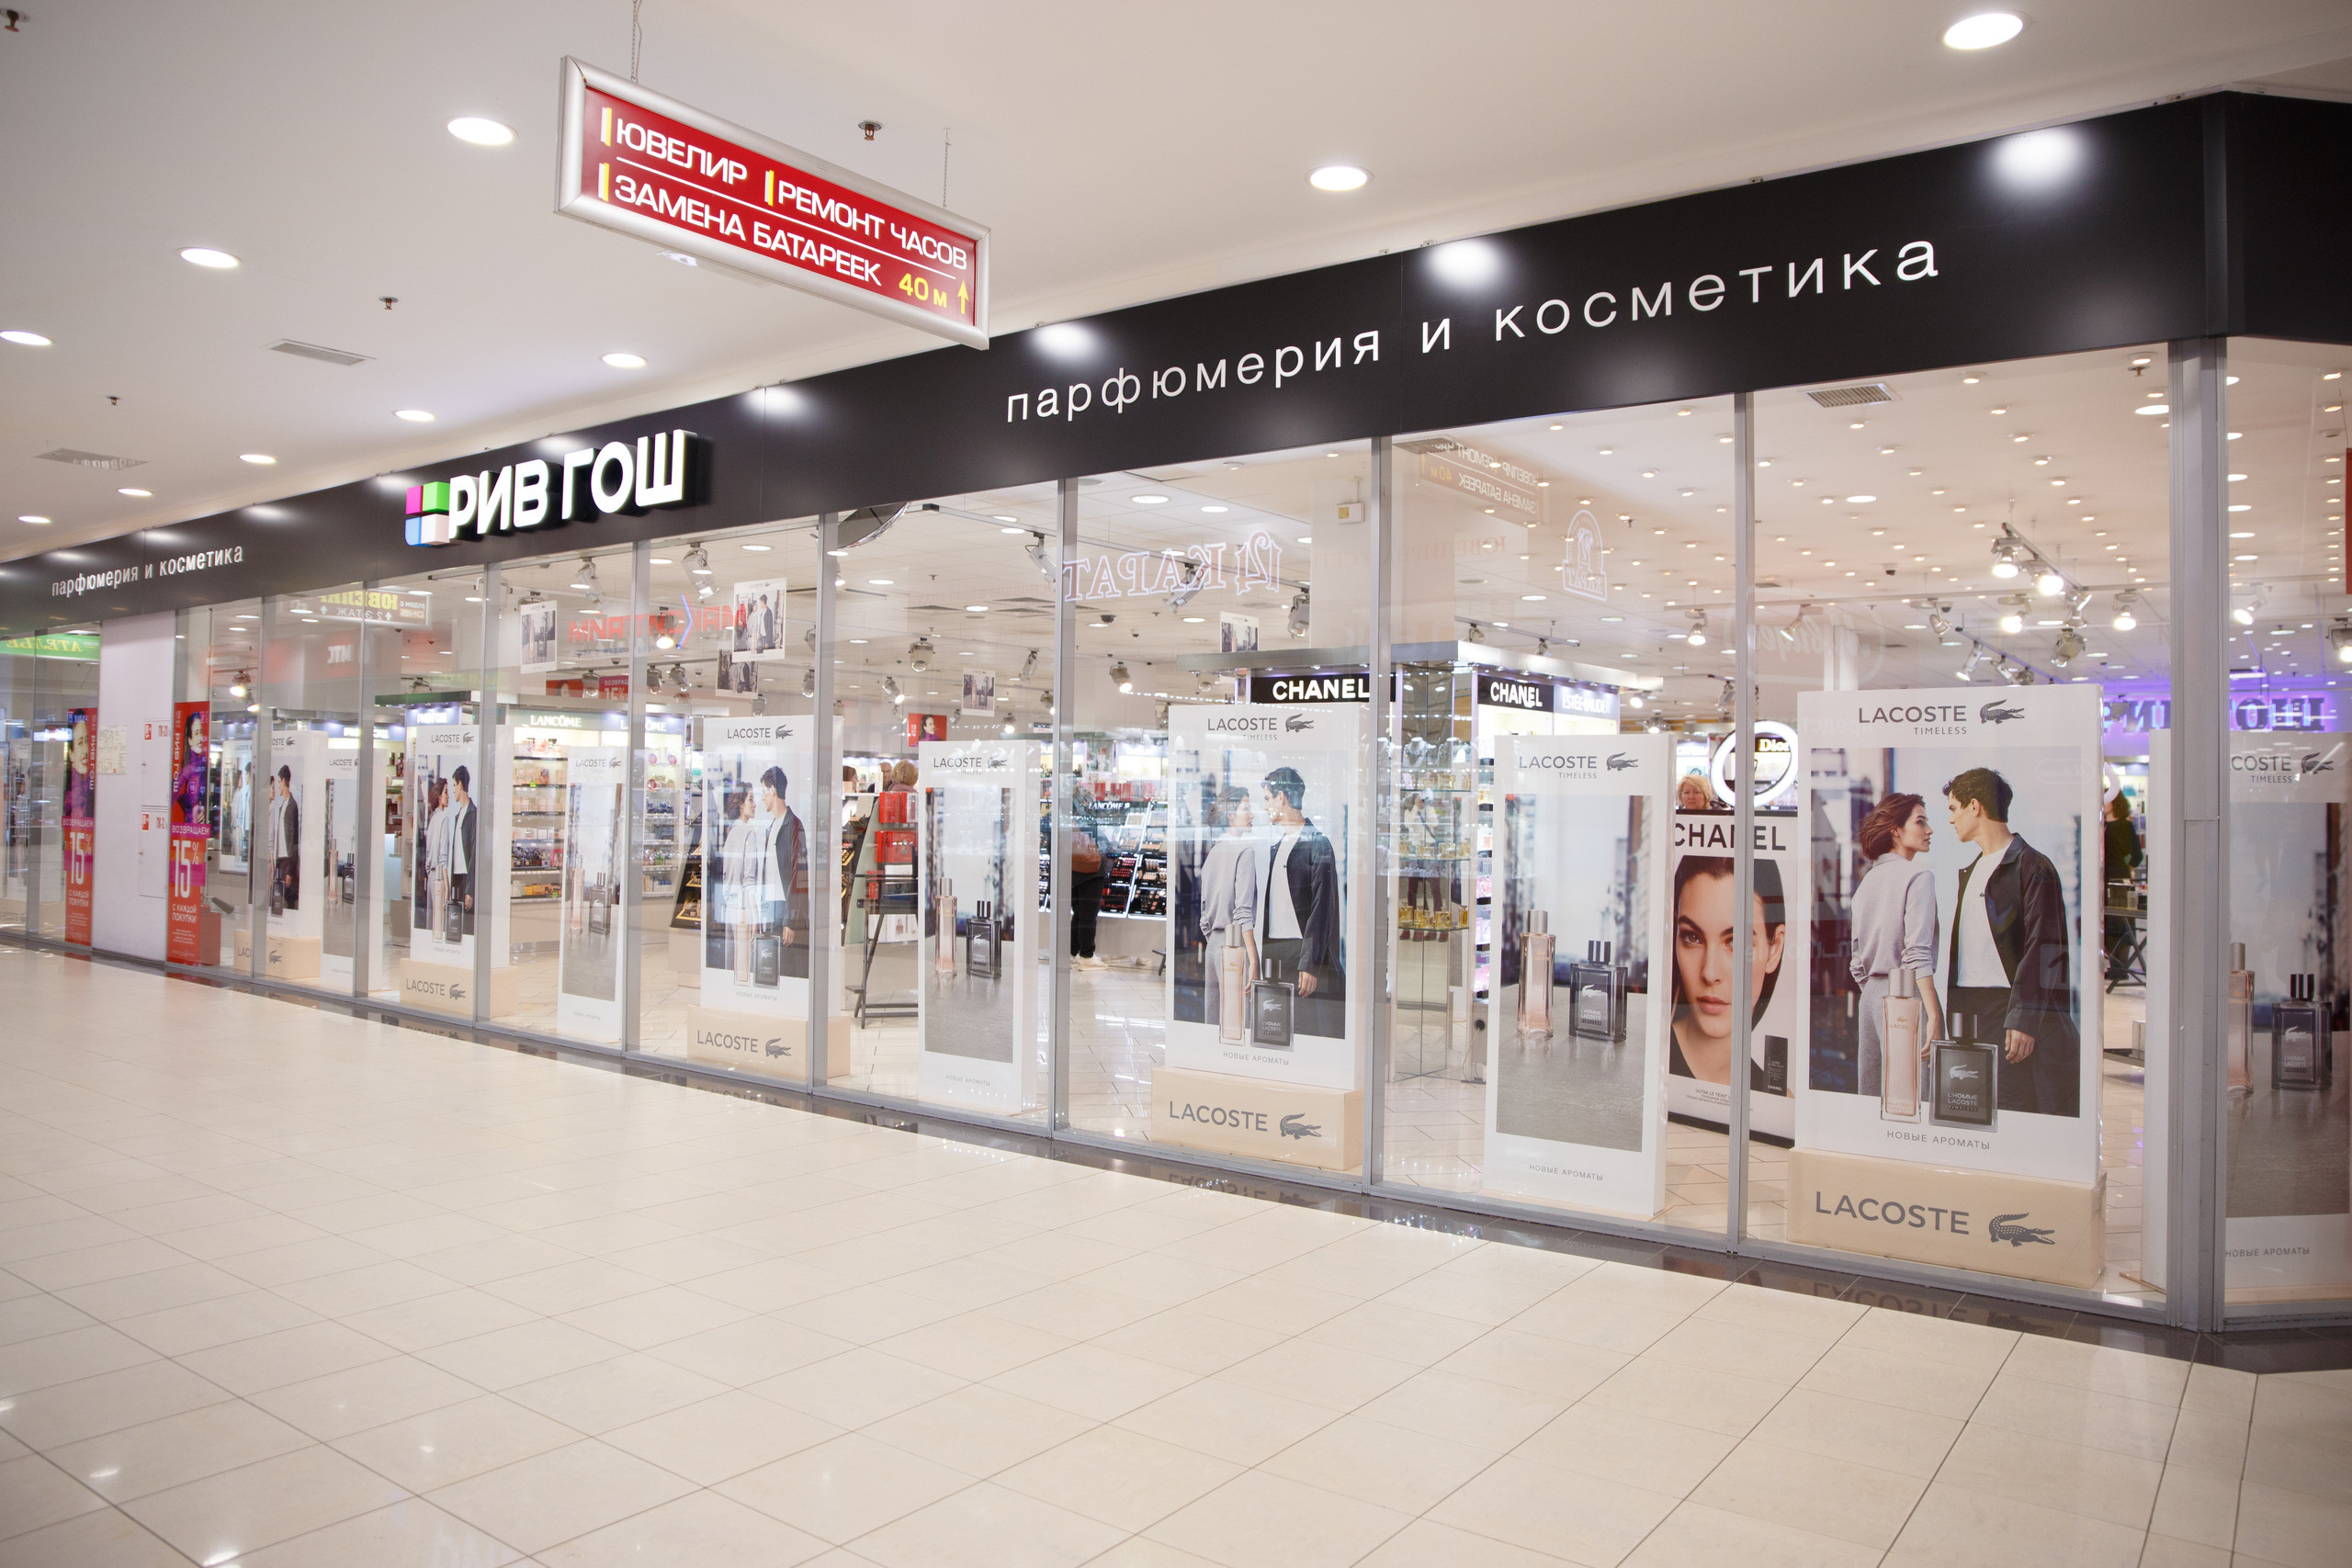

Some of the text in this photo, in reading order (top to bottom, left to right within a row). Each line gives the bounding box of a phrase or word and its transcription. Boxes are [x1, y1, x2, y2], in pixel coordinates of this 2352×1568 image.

[616, 117, 967, 270] ЮВЕЛИР РЕМОНТ ЧАСОВ
[614, 175, 746, 242] ЗАМЕНА
[752, 220, 882, 287] БАТАРЕЕК
[899, 272, 929, 301] 40
[1005, 238, 1939, 425] парфюмерия и косметика
[448, 428, 690, 540] РИВ ГОШ
[51, 545, 243, 598] парфюмерия и косметика
[1272, 678, 1370, 701] CHANEL
[1490, 681, 1543, 708] CHANEL
[530, 714, 582, 728] LANCÔME
[1858, 705, 1967, 724] LACOSTE
[1207, 716, 1277, 733] LACOSTE
[1913, 726, 1967, 735] TIMELESS
[431, 734, 460, 743] LACOSTE
[727, 728, 771, 739] LACOSTE
[1242, 733, 1277, 742] TIMELESS
[1758, 738, 1791, 752] Dior
[330, 759, 353, 767] LACOSTE
[575, 758, 606, 769] LACOSTE
[933, 757, 982, 768] LACOSTE
[1519, 755, 1598, 769] LACOSTE
[2251, 775, 2292, 784] TIMELESS
[172, 825, 209, 836] ВОЗВРАЩАЕМ
[406, 977, 446, 997] LACOSTE
[697, 1030, 759, 1054] LACOSTE
[1223, 1051, 1290, 1066] НОВЫЕ АРОМАТЫ
[1947, 1099, 1978, 1107] LACOSTE
[1169, 1100, 1269, 1133] LACOSTE
[1886, 1130, 1991, 1150] НОВЫЕ АРОМАТЫ
[1529, 1163, 1604, 1181] НОВЫЕ АРОМАТЫ
[1815, 1190, 1970, 1235] LACOSTE
[2225, 1247, 2311, 1258] НОВЫЕ АРОМАТЫ
